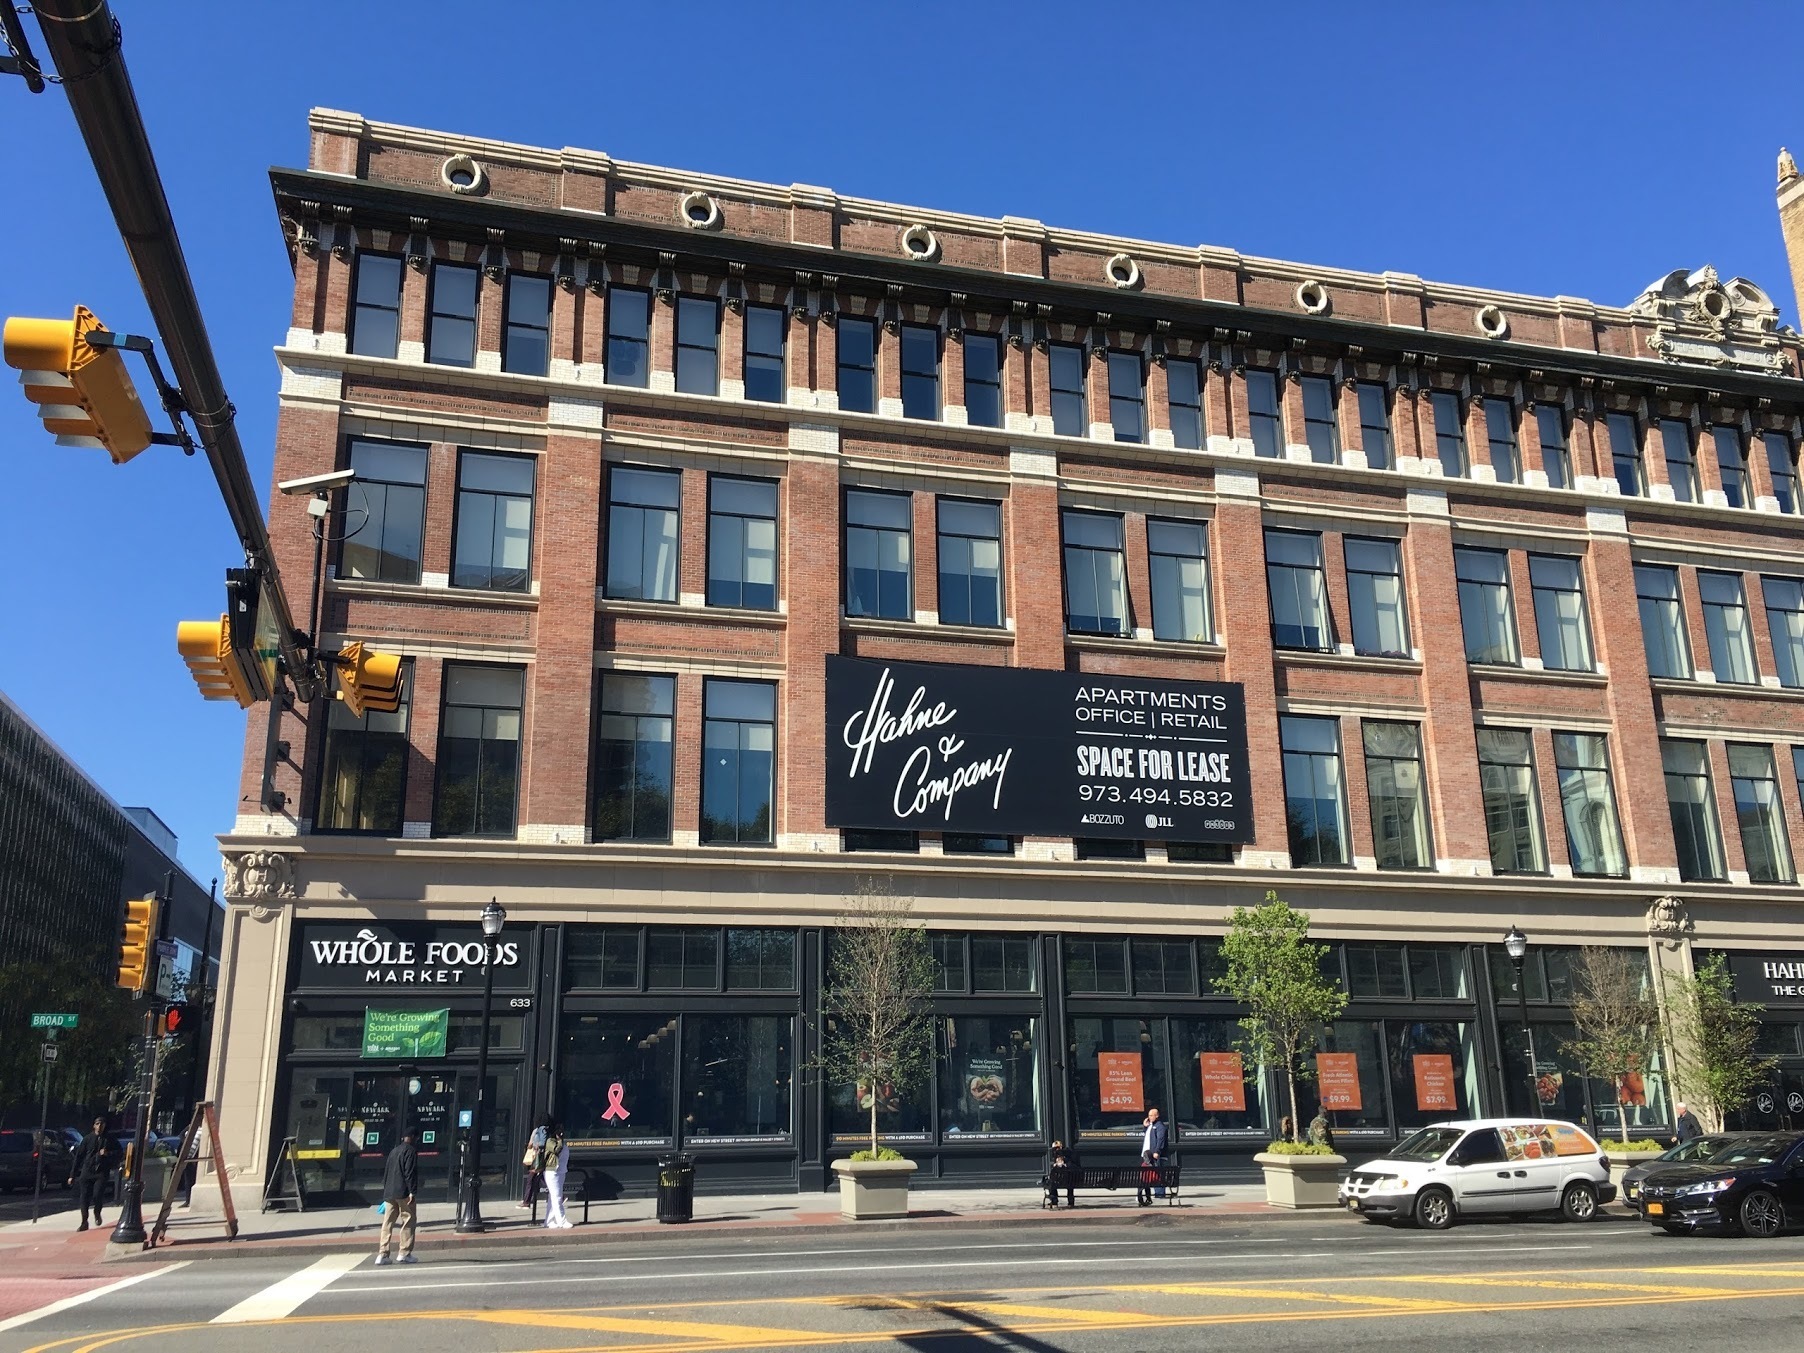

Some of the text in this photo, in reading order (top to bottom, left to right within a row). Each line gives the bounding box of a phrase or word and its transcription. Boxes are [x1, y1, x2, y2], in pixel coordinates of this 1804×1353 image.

[1075, 687, 1227, 711] APARTMENTS
[843, 667, 957, 778] Hahne
[1075, 707, 1228, 730] OFFICE RETAIL
[1076, 745, 1232, 783] SPACE FOR LEASE
[893, 746, 1013, 821] Company
[1079, 784, 1234, 808] 973.494.5832
[1089, 813, 1125, 825] BOZZUTO
[1158, 816, 1174, 827] JLL
[310, 940, 518, 965] WHOLE FOODS
[365, 970, 464, 983] MARKET
[1771, 985, 1797, 996] THE
[510, 998, 531, 1008] 633
[33, 1015, 64, 1026] BROAD
[370, 1012, 440, 1023] We're Growing
[368, 1023, 420, 1034] Something
[368, 1033, 395, 1042] Good
[1110, 1096, 1132, 1104] $4.99
[1426, 1096, 1446, 1104] $7.99
